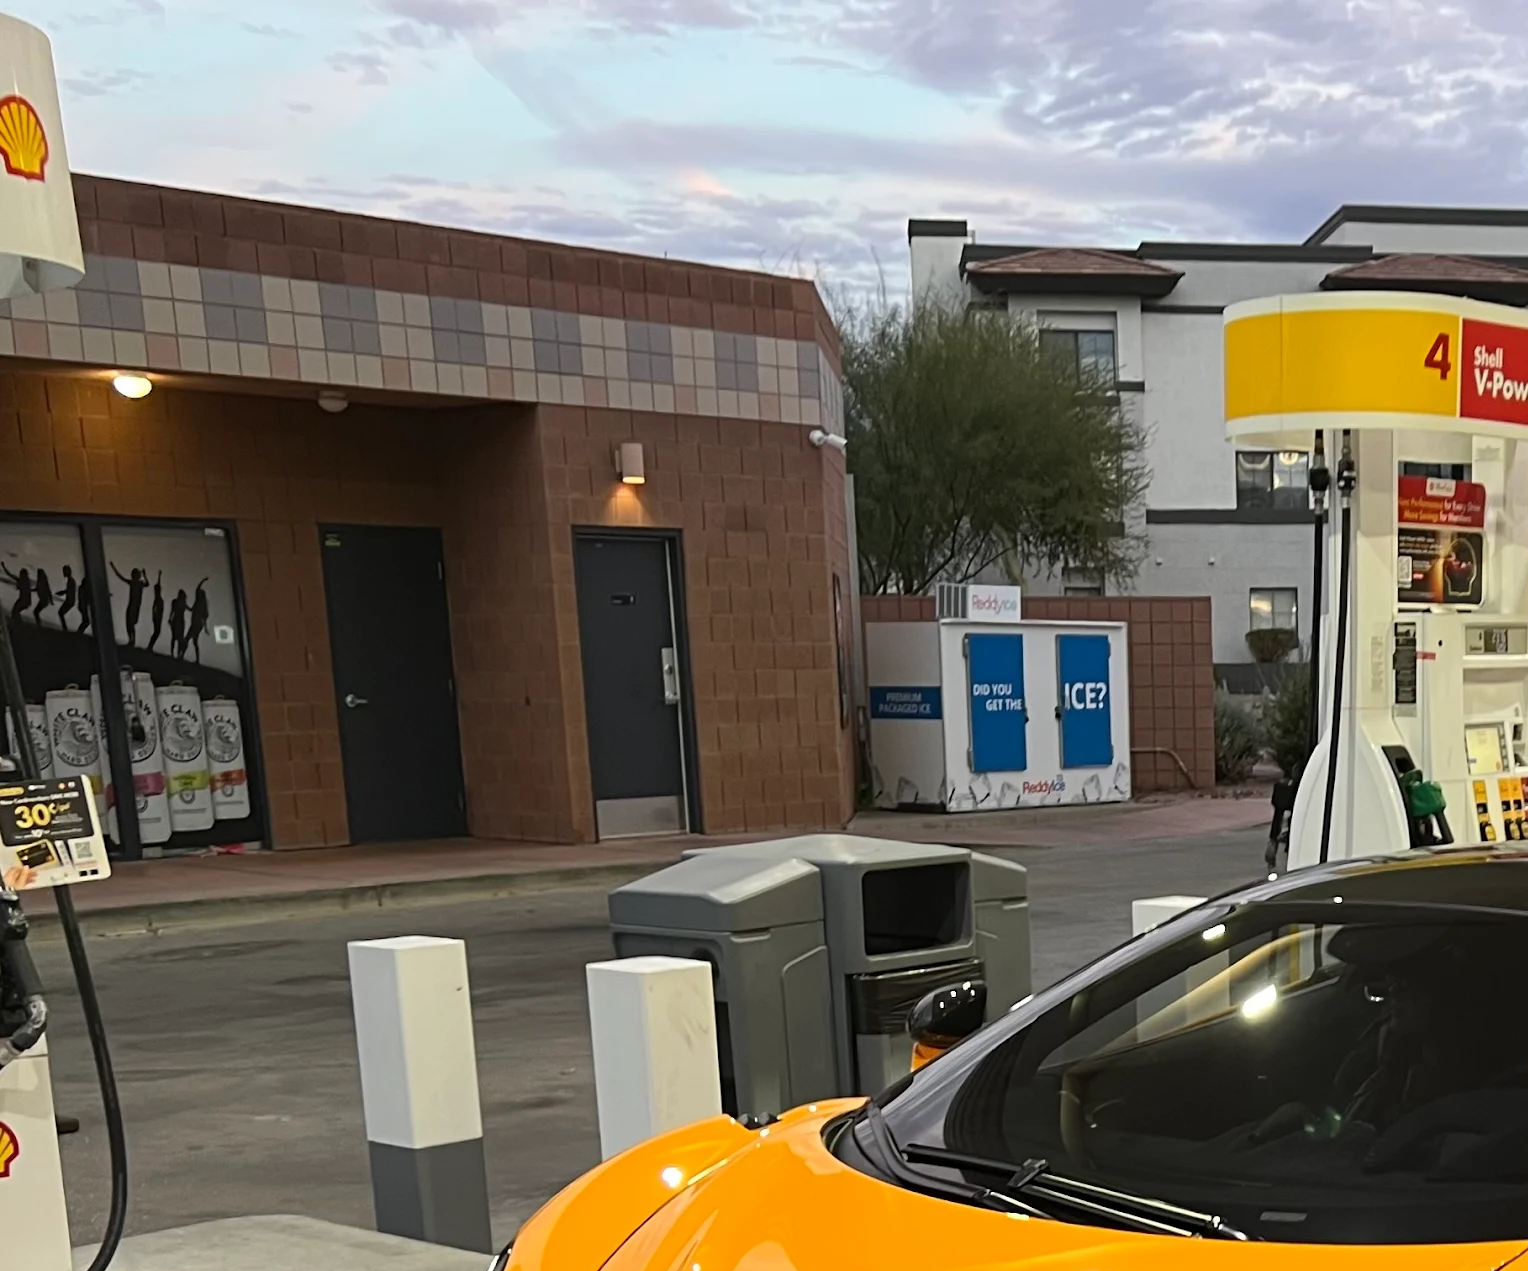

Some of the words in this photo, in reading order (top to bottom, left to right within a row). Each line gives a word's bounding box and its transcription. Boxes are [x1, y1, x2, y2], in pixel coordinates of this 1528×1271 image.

[1424, 332, 1452, 380] 4
[1474, 345, 1504, 368] Shell
[973, 683, 990, 696] DID
[992, 683, 1012, 696] YOU
[1064, 682, 1107, 711] ICE?
[985, 698, 1004, 711] GET
[1005, 698, 1022, 711] THE
[67, 708, 96, 727] CLAW
